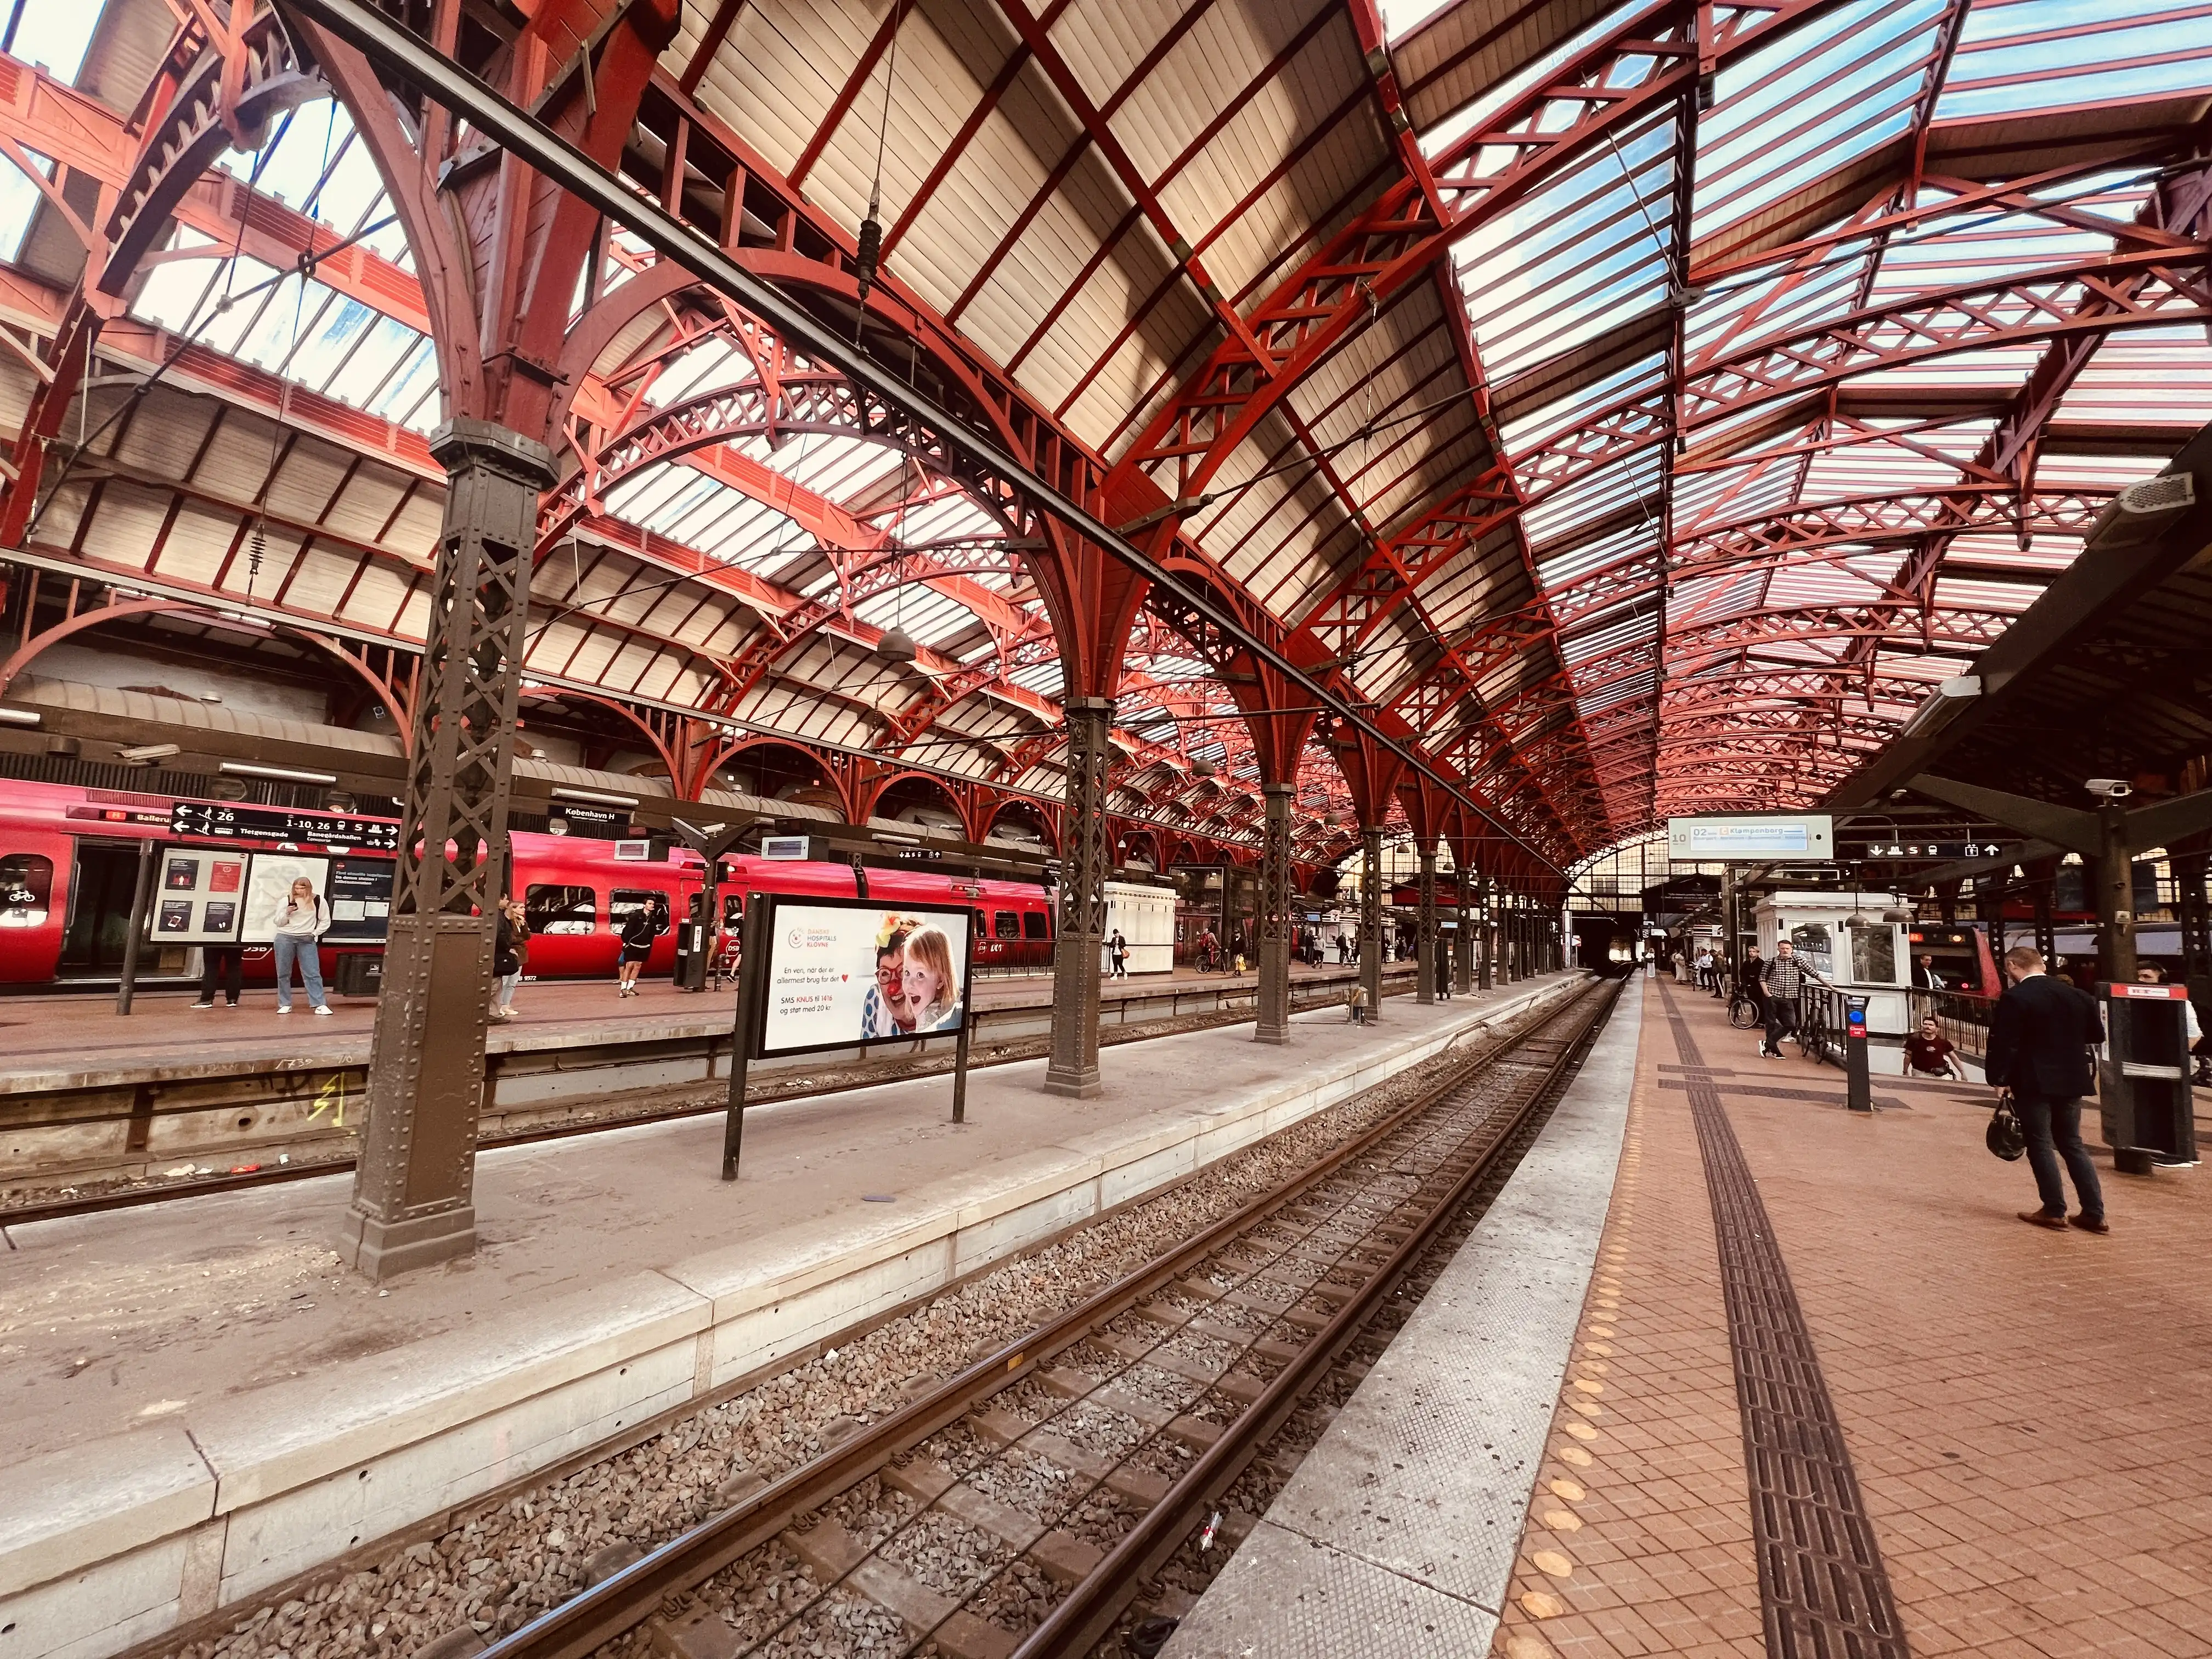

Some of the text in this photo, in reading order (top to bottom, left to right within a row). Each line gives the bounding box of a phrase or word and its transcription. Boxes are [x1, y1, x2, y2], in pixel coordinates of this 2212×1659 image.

[217, 811, 234, 821] 26
[565, 808, 607, 819] København
[137, 815, 171, 823] Balleru
[286, 819, 330, 830] 1-10, 26
[240, 828, 289, 838] Tietgensgade
[307, 831, 362, 840] Banegårdshallen
[1672, 834, 1686, 842] 10
